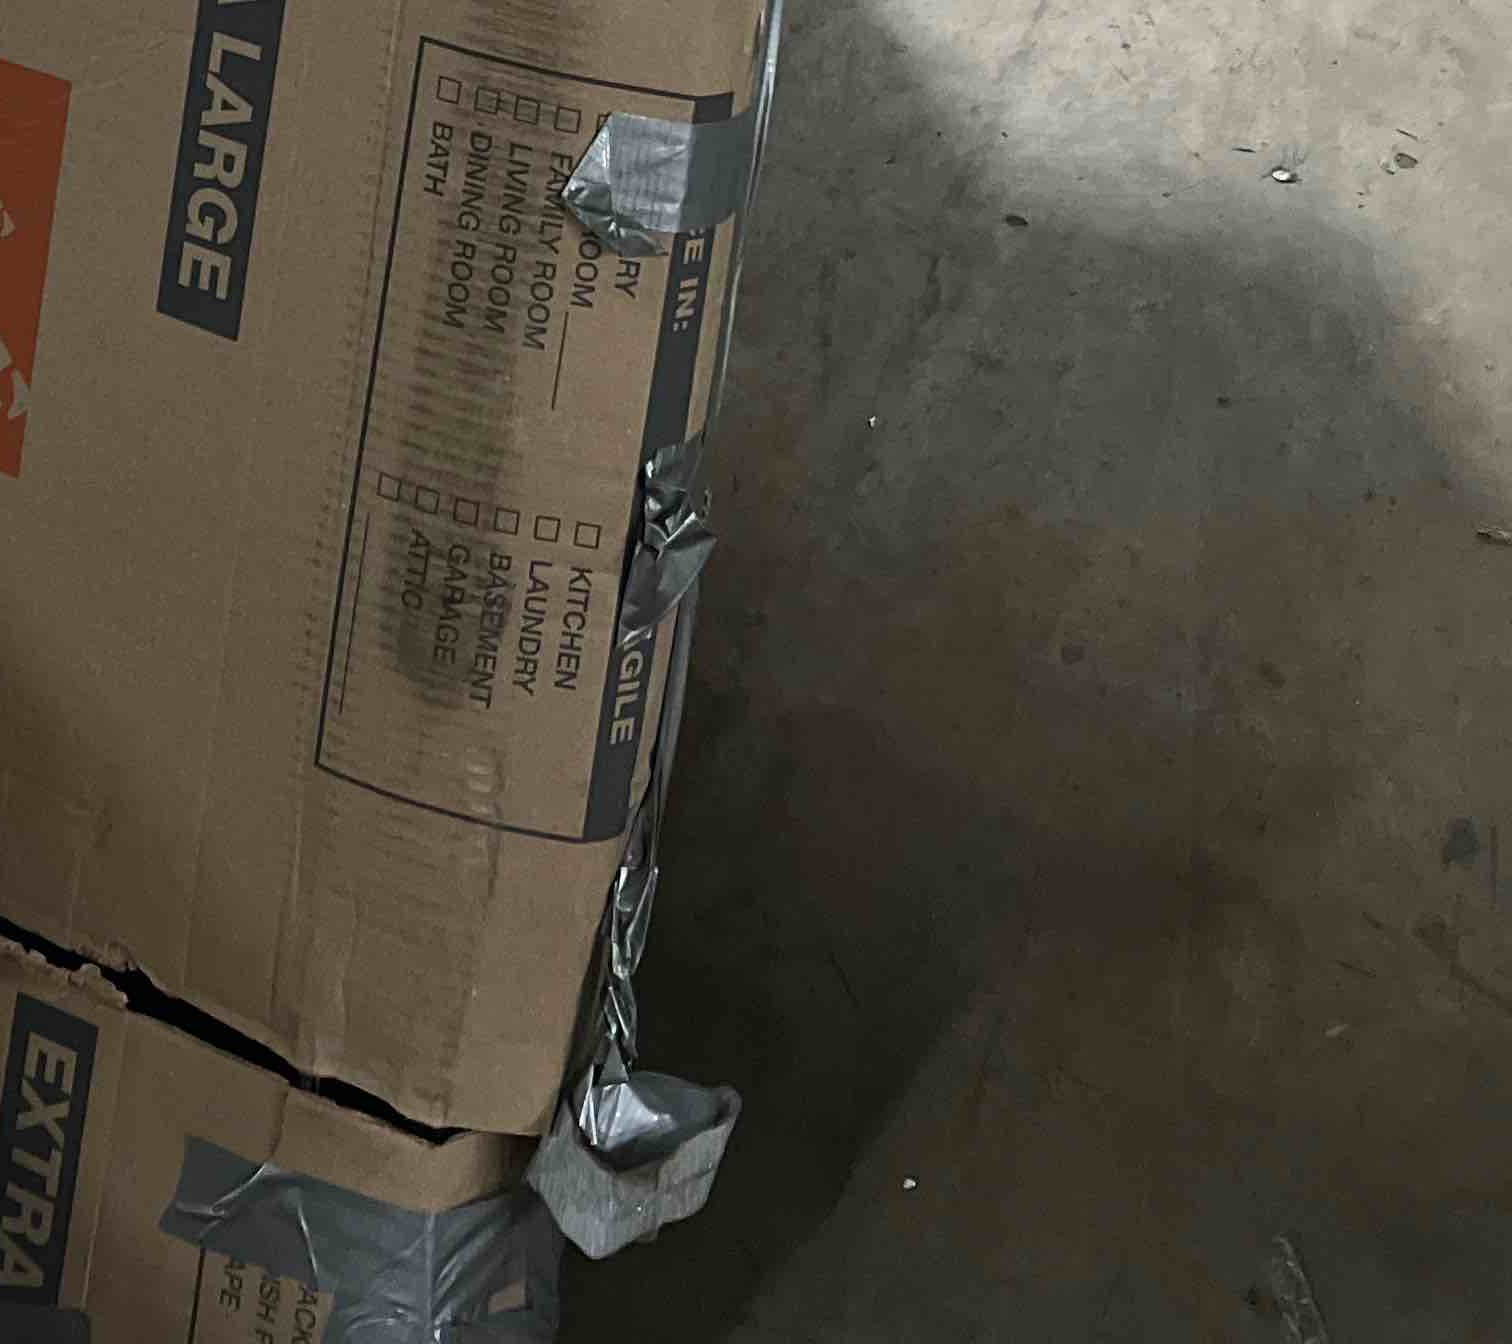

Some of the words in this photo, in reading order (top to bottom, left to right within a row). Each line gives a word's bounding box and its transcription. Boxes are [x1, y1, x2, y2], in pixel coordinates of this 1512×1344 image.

[176, 29, 263, 303] LARGE
[424, 120, 454, 197] BATH
[458, 130, 492, 232] DINING
[498, 141, 533, 237] LIVING
[442, 239, 476, 329] ROOM
[482, 242, 516, 334] ROOM
[522, 261, 557, 351] ROOM
[400, 528, 430, 610] ATTIC
[434, 543, 470, 665] GARAGE
[468, 551, 513, 709] BASEMENT
[513, 559, 553, 697] LAUNDRY
[553, 565, 593, 691] KITCHEN
[610, 643, 644, 745] GILE
